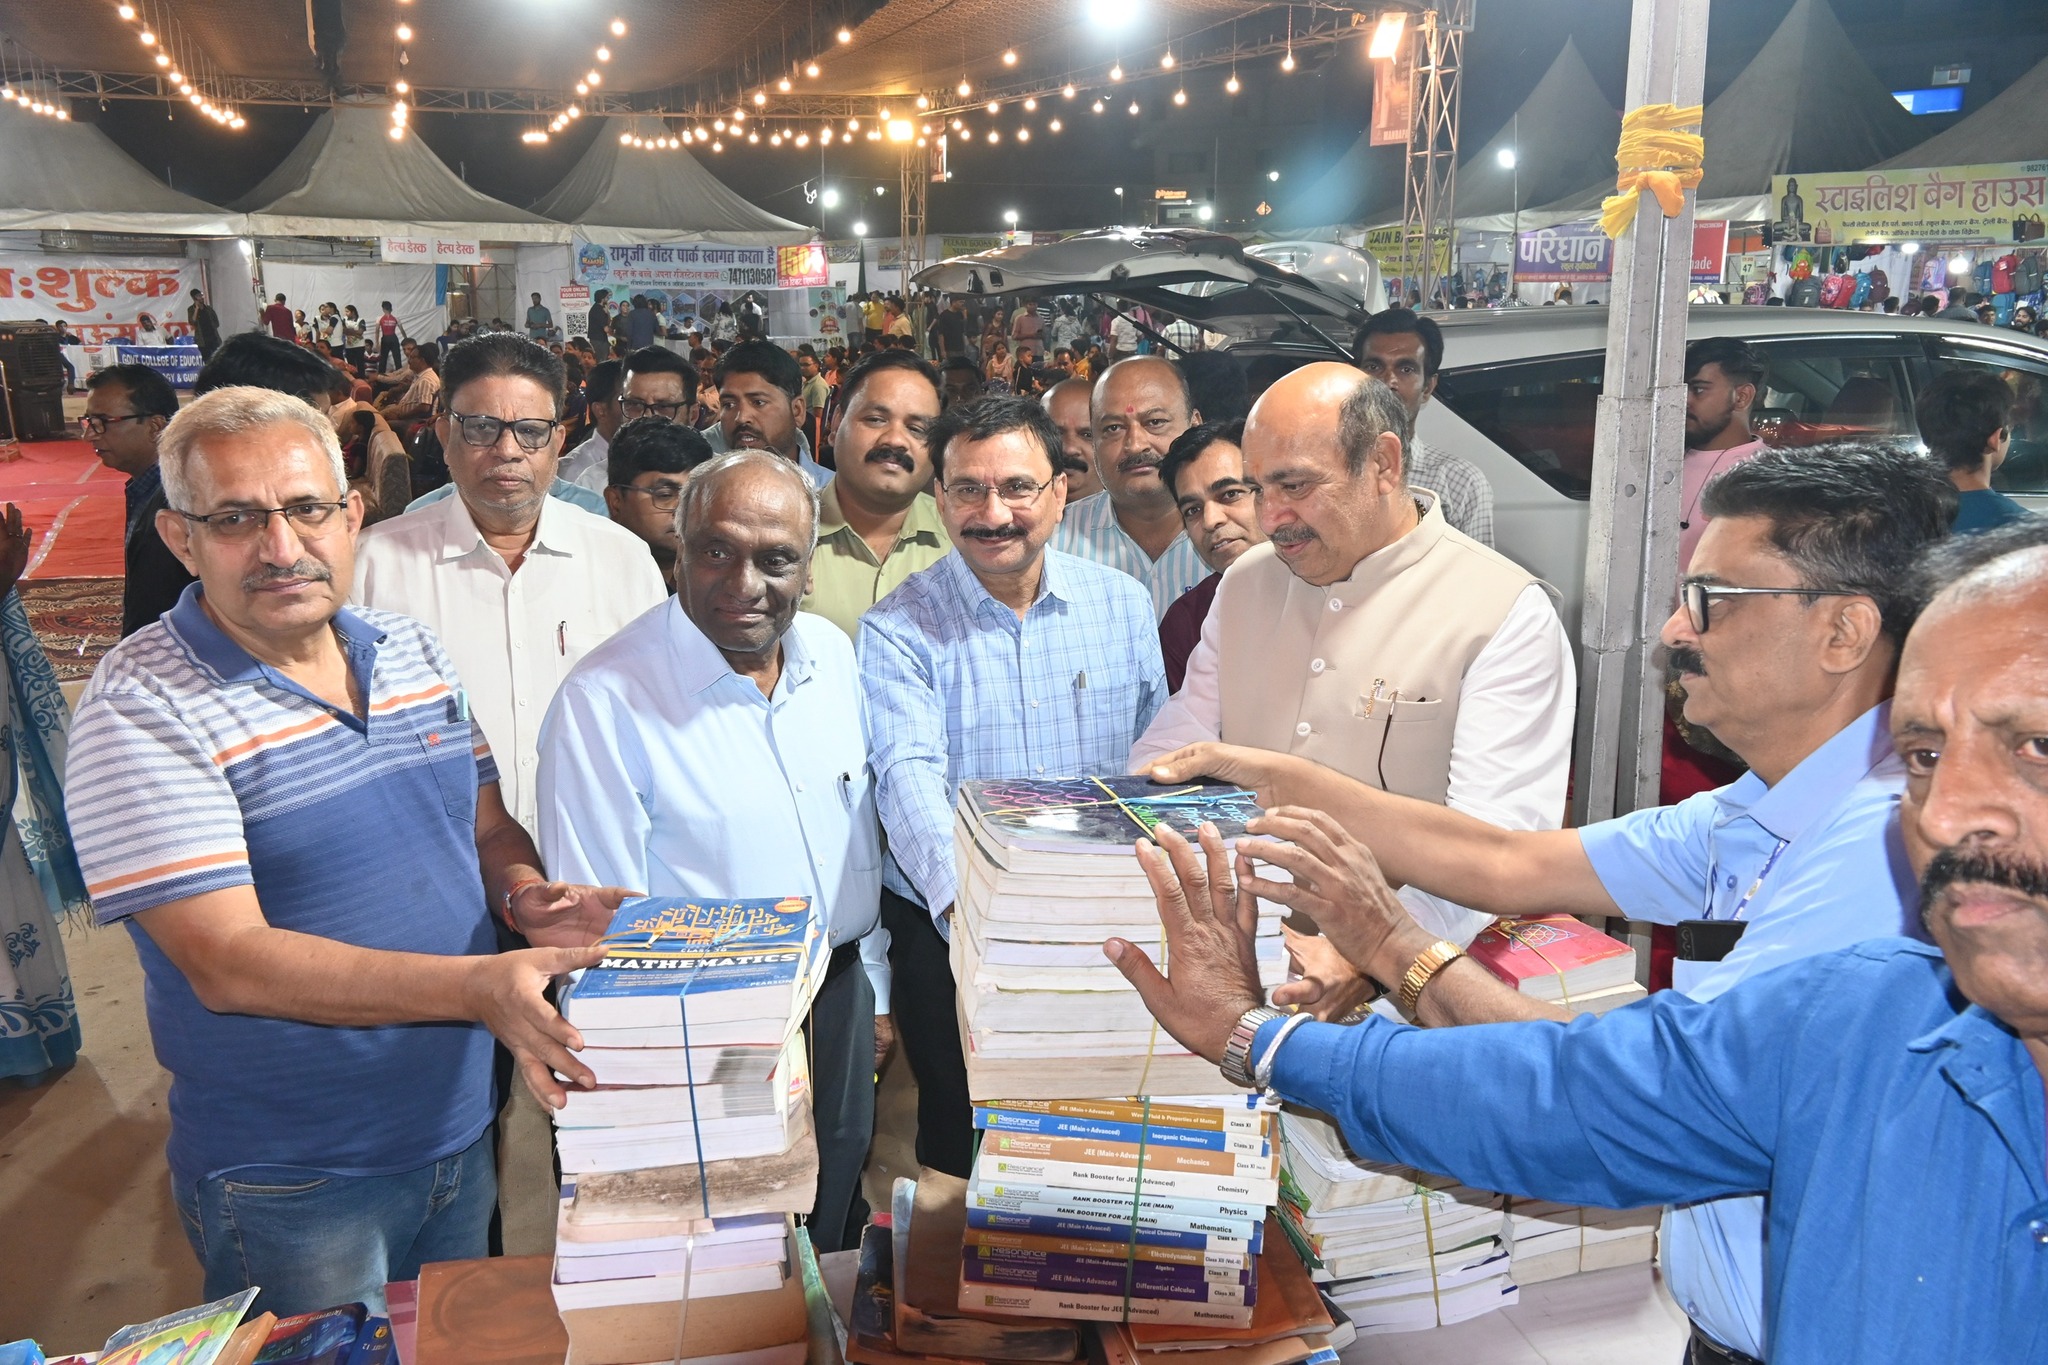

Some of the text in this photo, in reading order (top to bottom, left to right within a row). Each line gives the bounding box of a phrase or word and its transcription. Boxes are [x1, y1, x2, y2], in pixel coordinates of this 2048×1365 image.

[1815, 172, 2047, 213] स्टाइलिश बैग हाउस
[1370, 232, 1392, 243] JAIN
[407, 240, 426, 253] डेस्क
[437, 241, 474, 255] हेल्प डेस्क
[1520, 229, 1606, 263] परिधान
[610, 244, 775, 267] रामूजी वॉटर पार्क स्वागत करता है
[1743, 264, 1752, 272] 47
[728, 268, 776, 285] 7471130587
[142, 355, 169, 366] COLLEGE
[171, 355, 178, 365] OF
[177, 373, 182, 382] &
[599, 953, 797, 969] MATHEMATICS
[998, 1115, 1040, 1124] Resonance
[1152, 1133, 1208, 1145] Inorganic Chemistry
[1177, 1157, 1210, 1166] Mechanics
[1090, 1173, 1114, 1181] Booster
[1217, 1185, 1249, 1194] Chemistry
[1093, 1197, 1123, 1205] BOOSTER
[1077, 1209, 1107, 1217] BOOSTER
[1220, 1207, 1247, 1216] Physics
[1190, 1222, 1232, 1233] Mathematics
[1151, 1250, 1196, 1261] Electrodynamics
[995, 1264, 1038, 1275] Resonance
[1136, 1282, 1195, 1294] Differential Calculus
